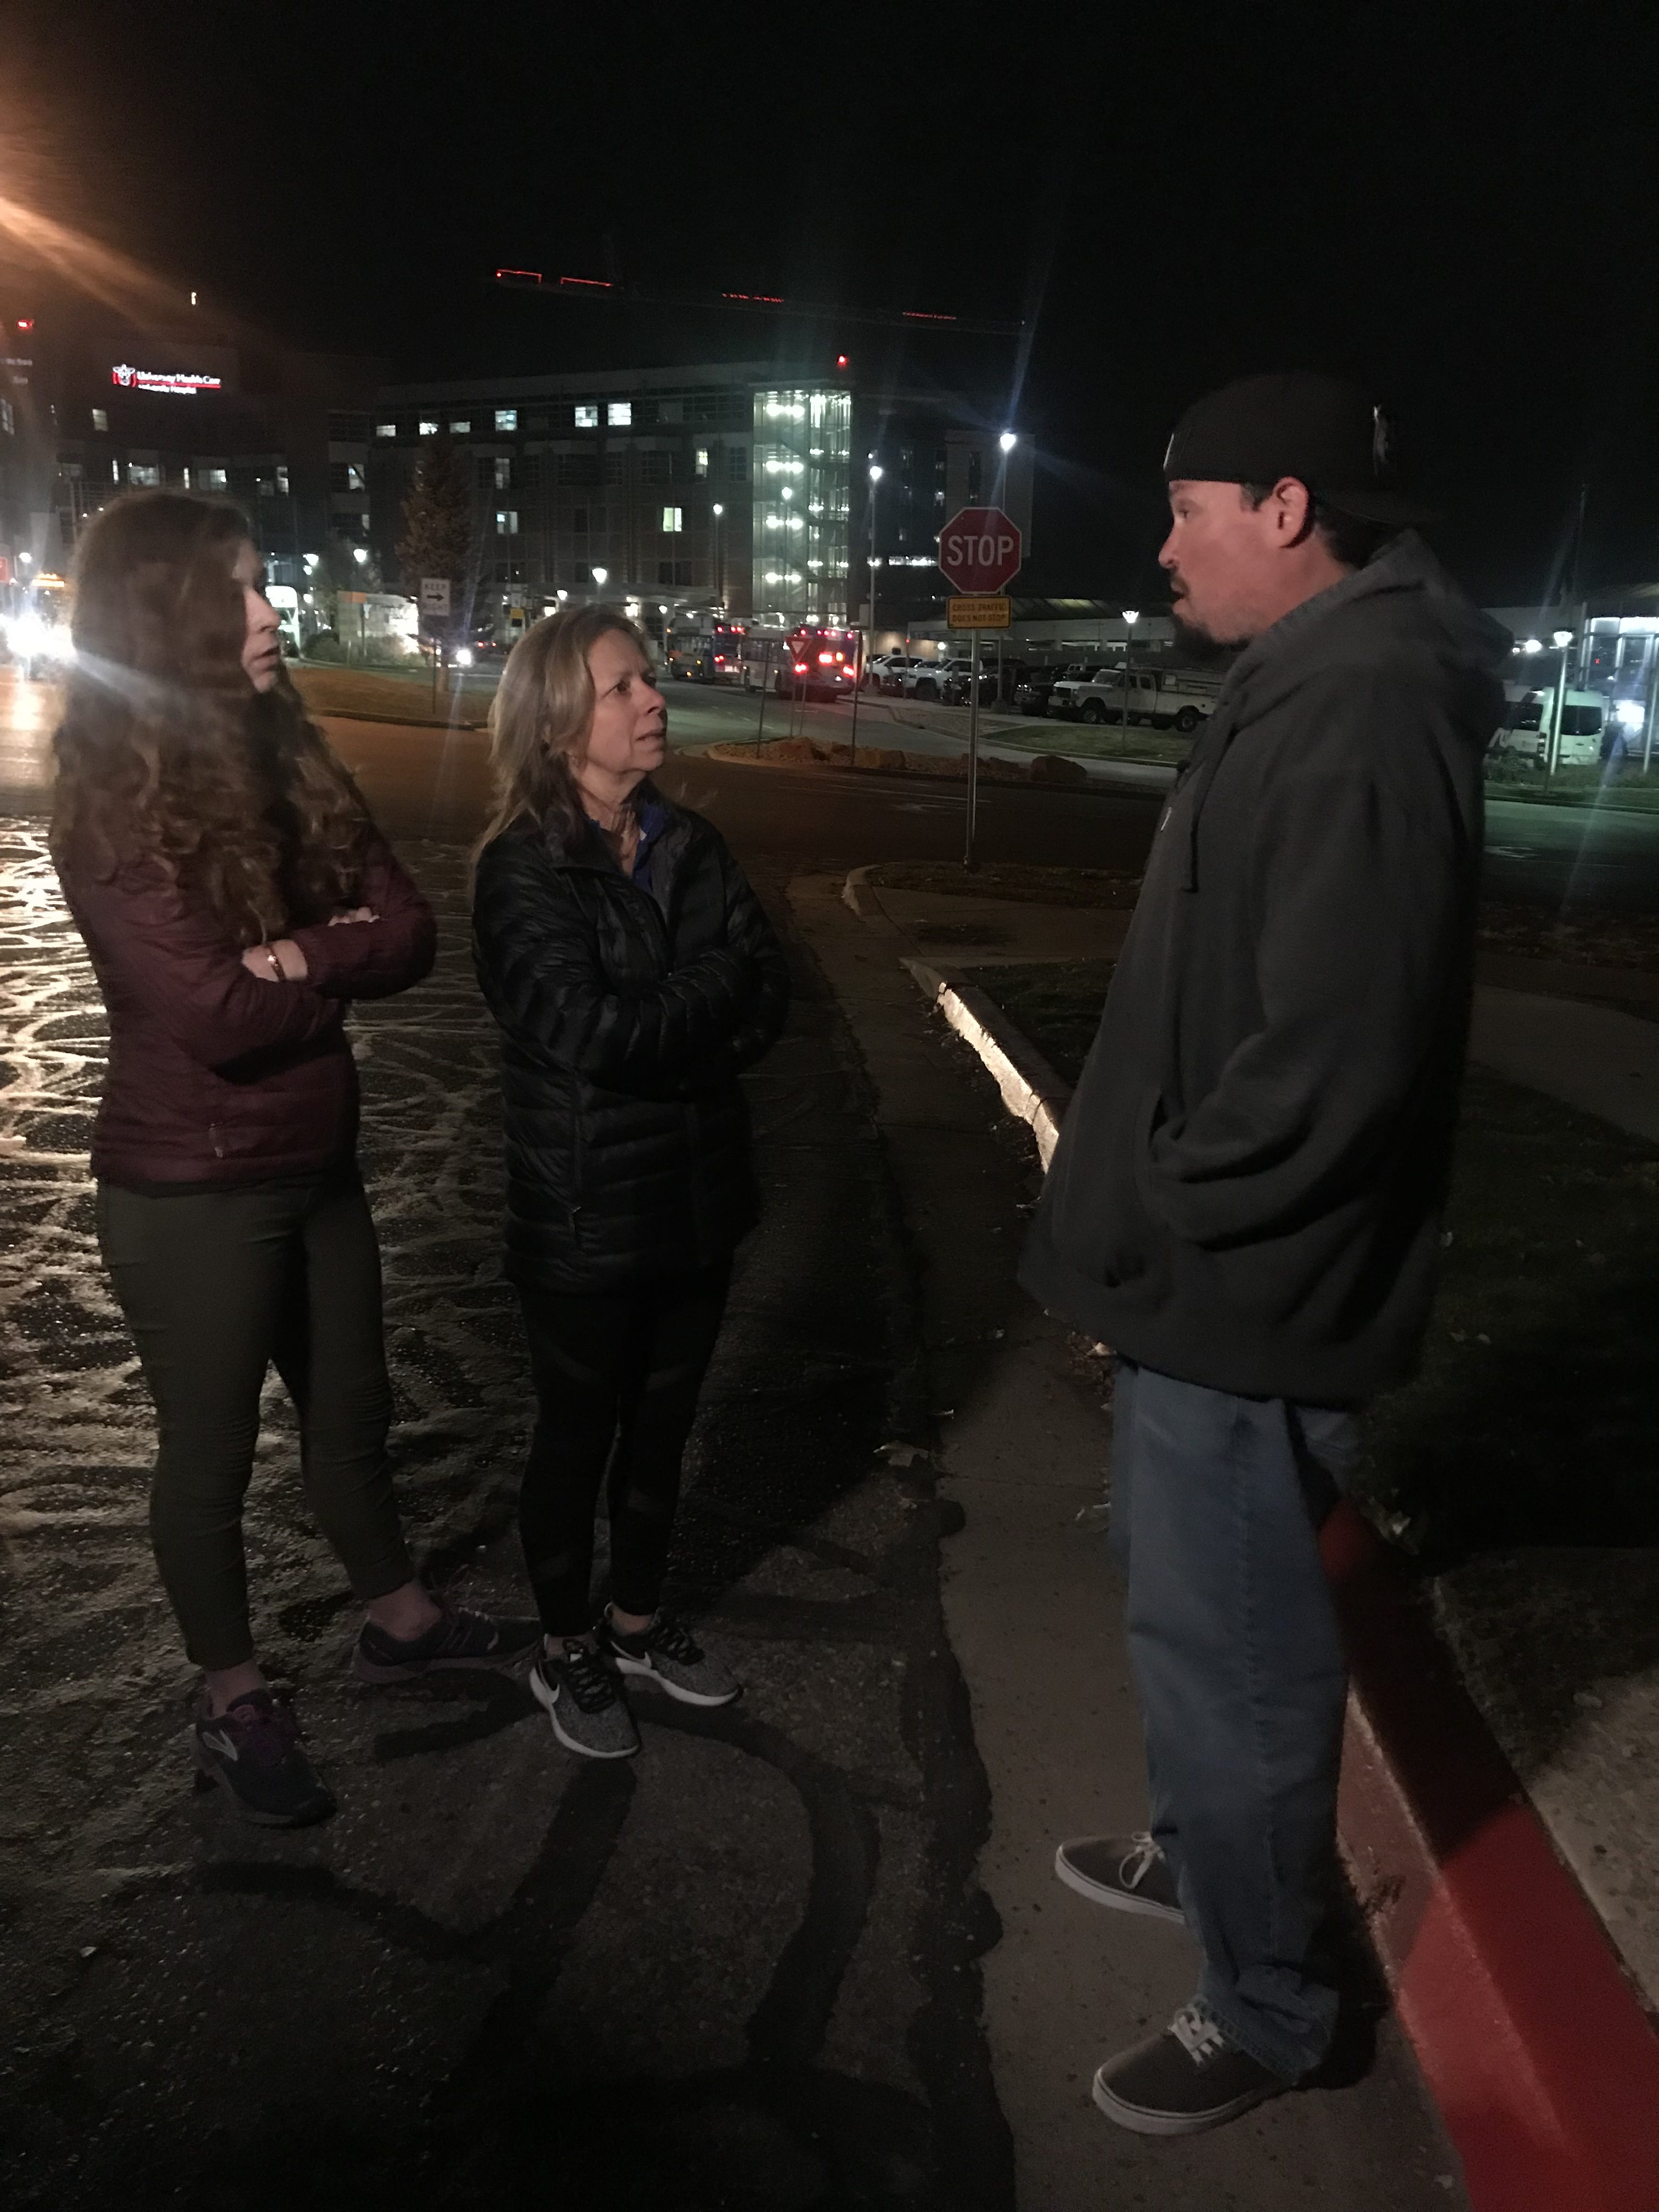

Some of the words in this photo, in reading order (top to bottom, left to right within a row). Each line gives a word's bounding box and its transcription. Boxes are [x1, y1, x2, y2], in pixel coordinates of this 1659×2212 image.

[946, 535, 1014, 566] STOP
[978, 603, 1006, 611] TRAFFIC
[988, 613, 1006, 622] STOP
